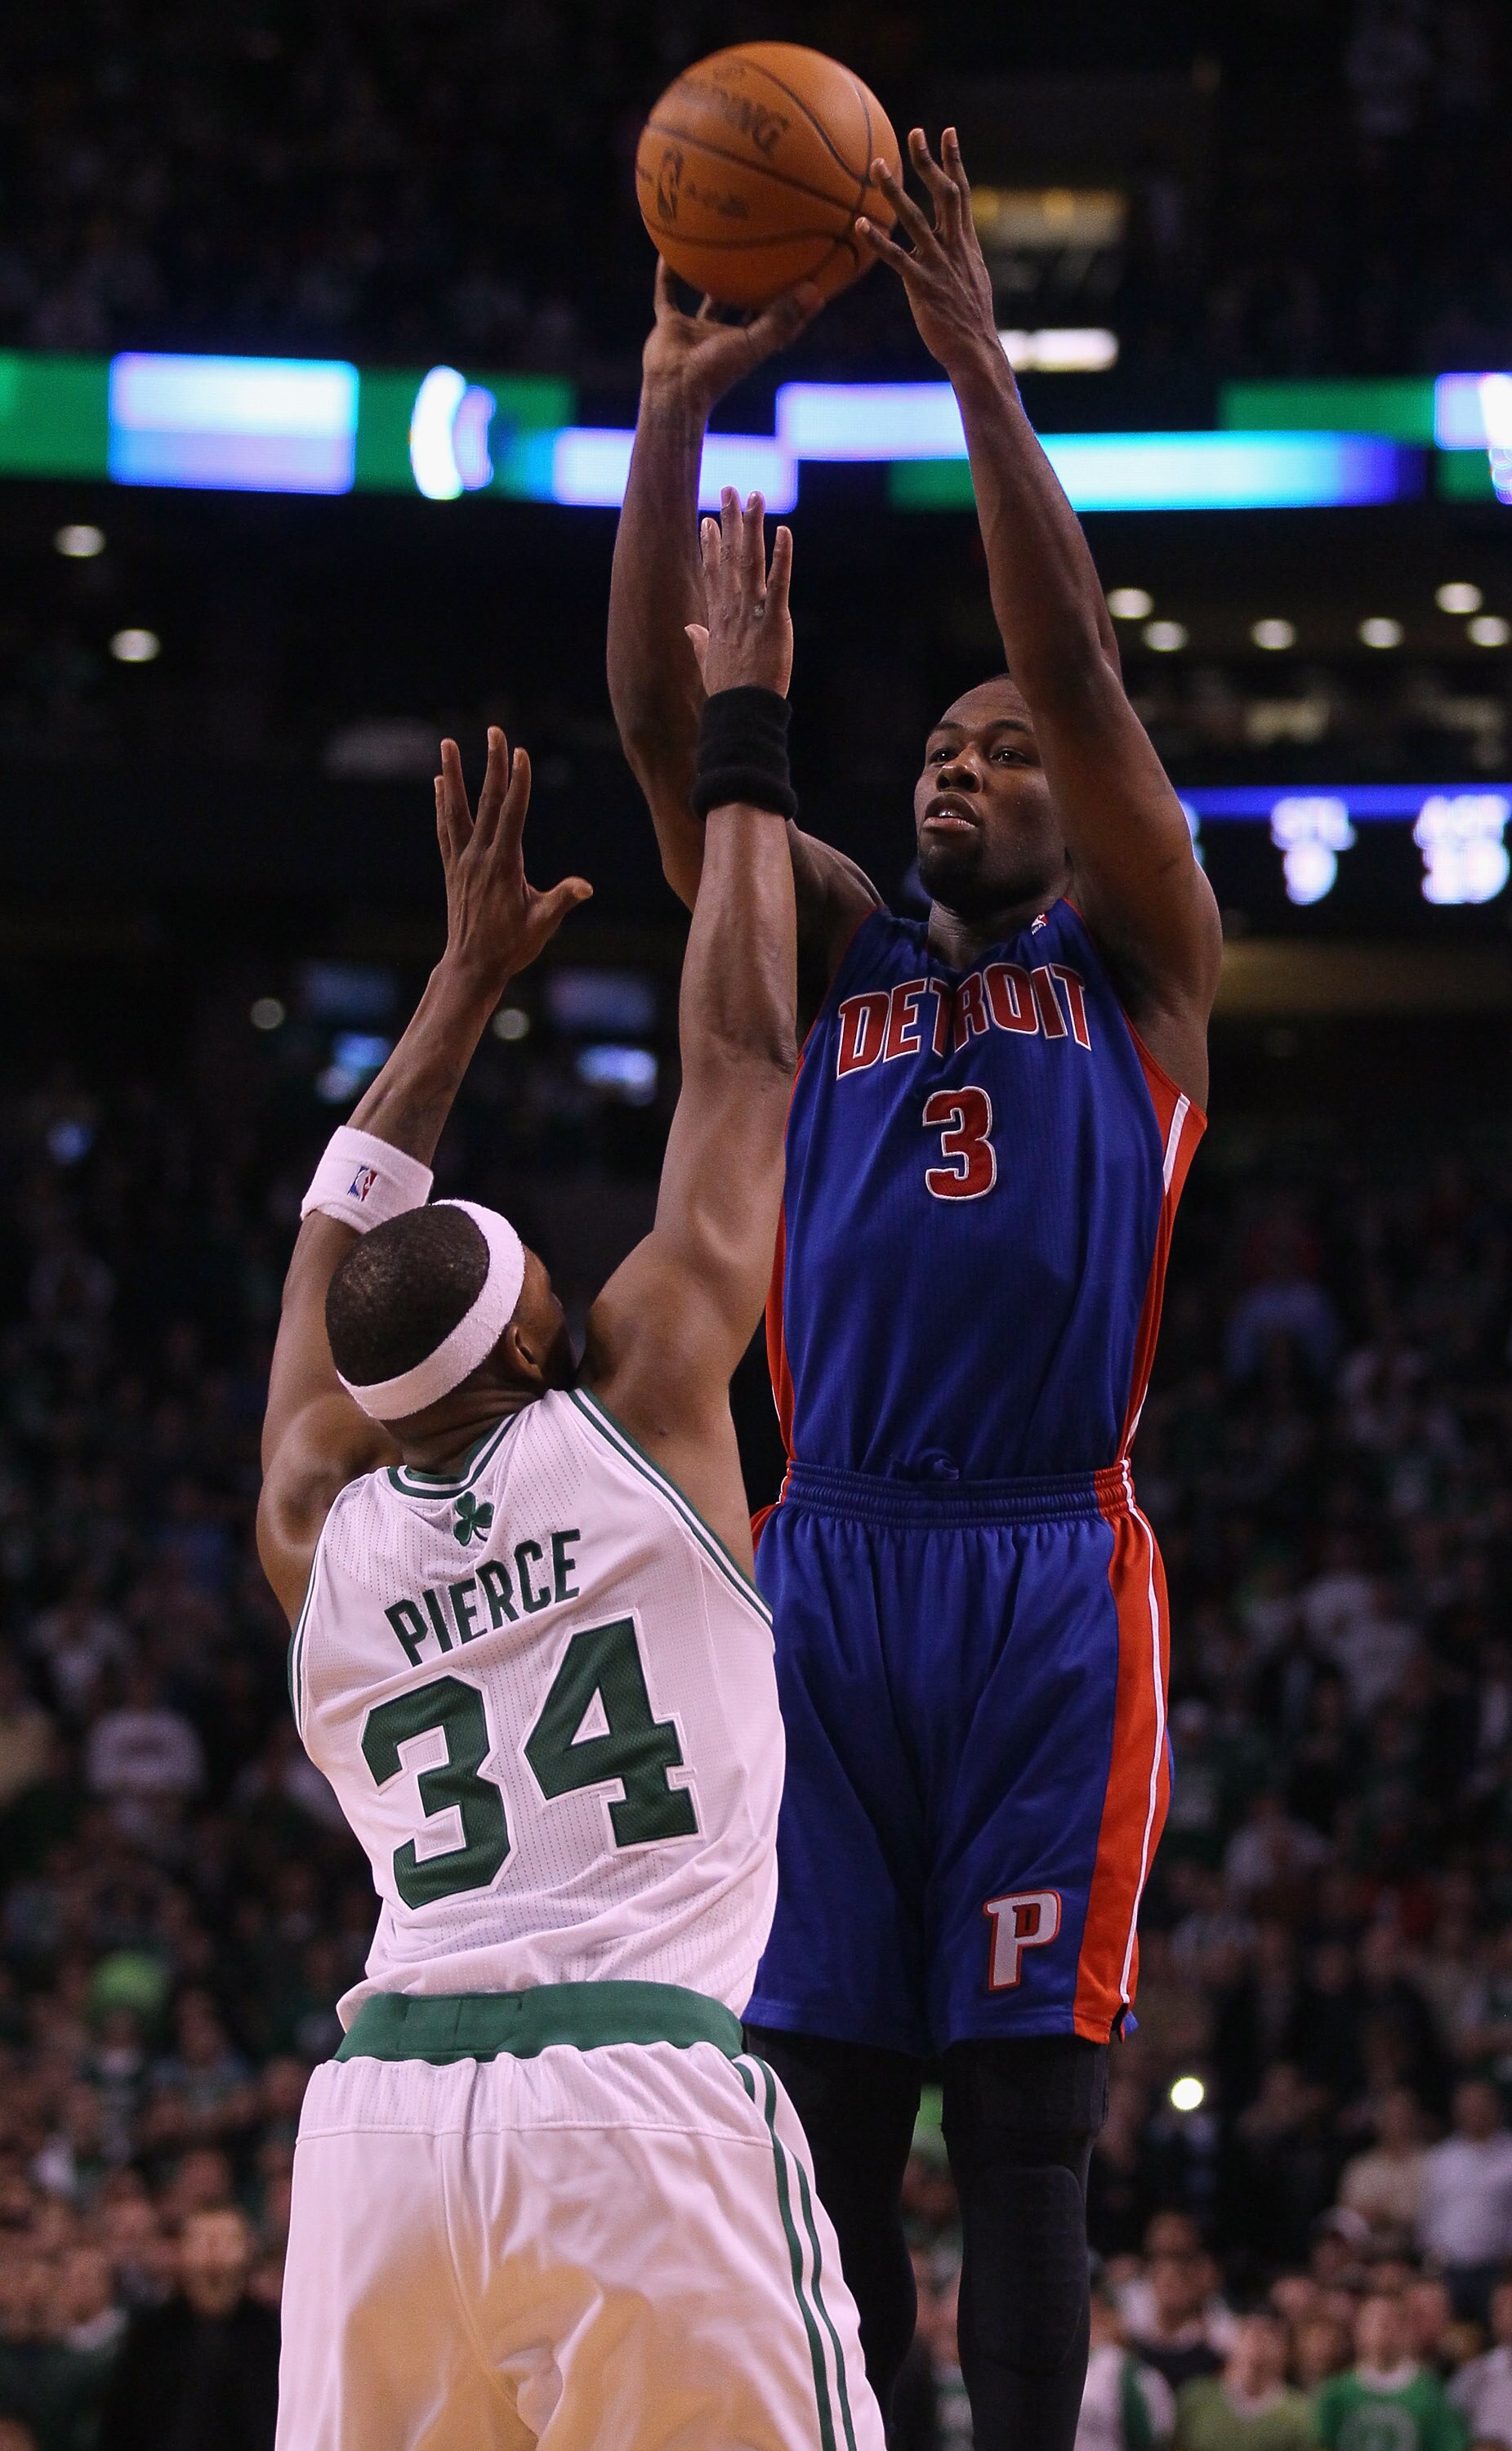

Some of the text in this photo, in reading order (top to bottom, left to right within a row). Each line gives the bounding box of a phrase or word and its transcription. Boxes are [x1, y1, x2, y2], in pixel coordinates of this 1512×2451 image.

[836, 962, 1092, 1080] DETROIT
[922, 1085, 997, 1201] 3
[384, 1528, 582, 1668] PIERCE
[359, 1607, 704, 1912] 34
